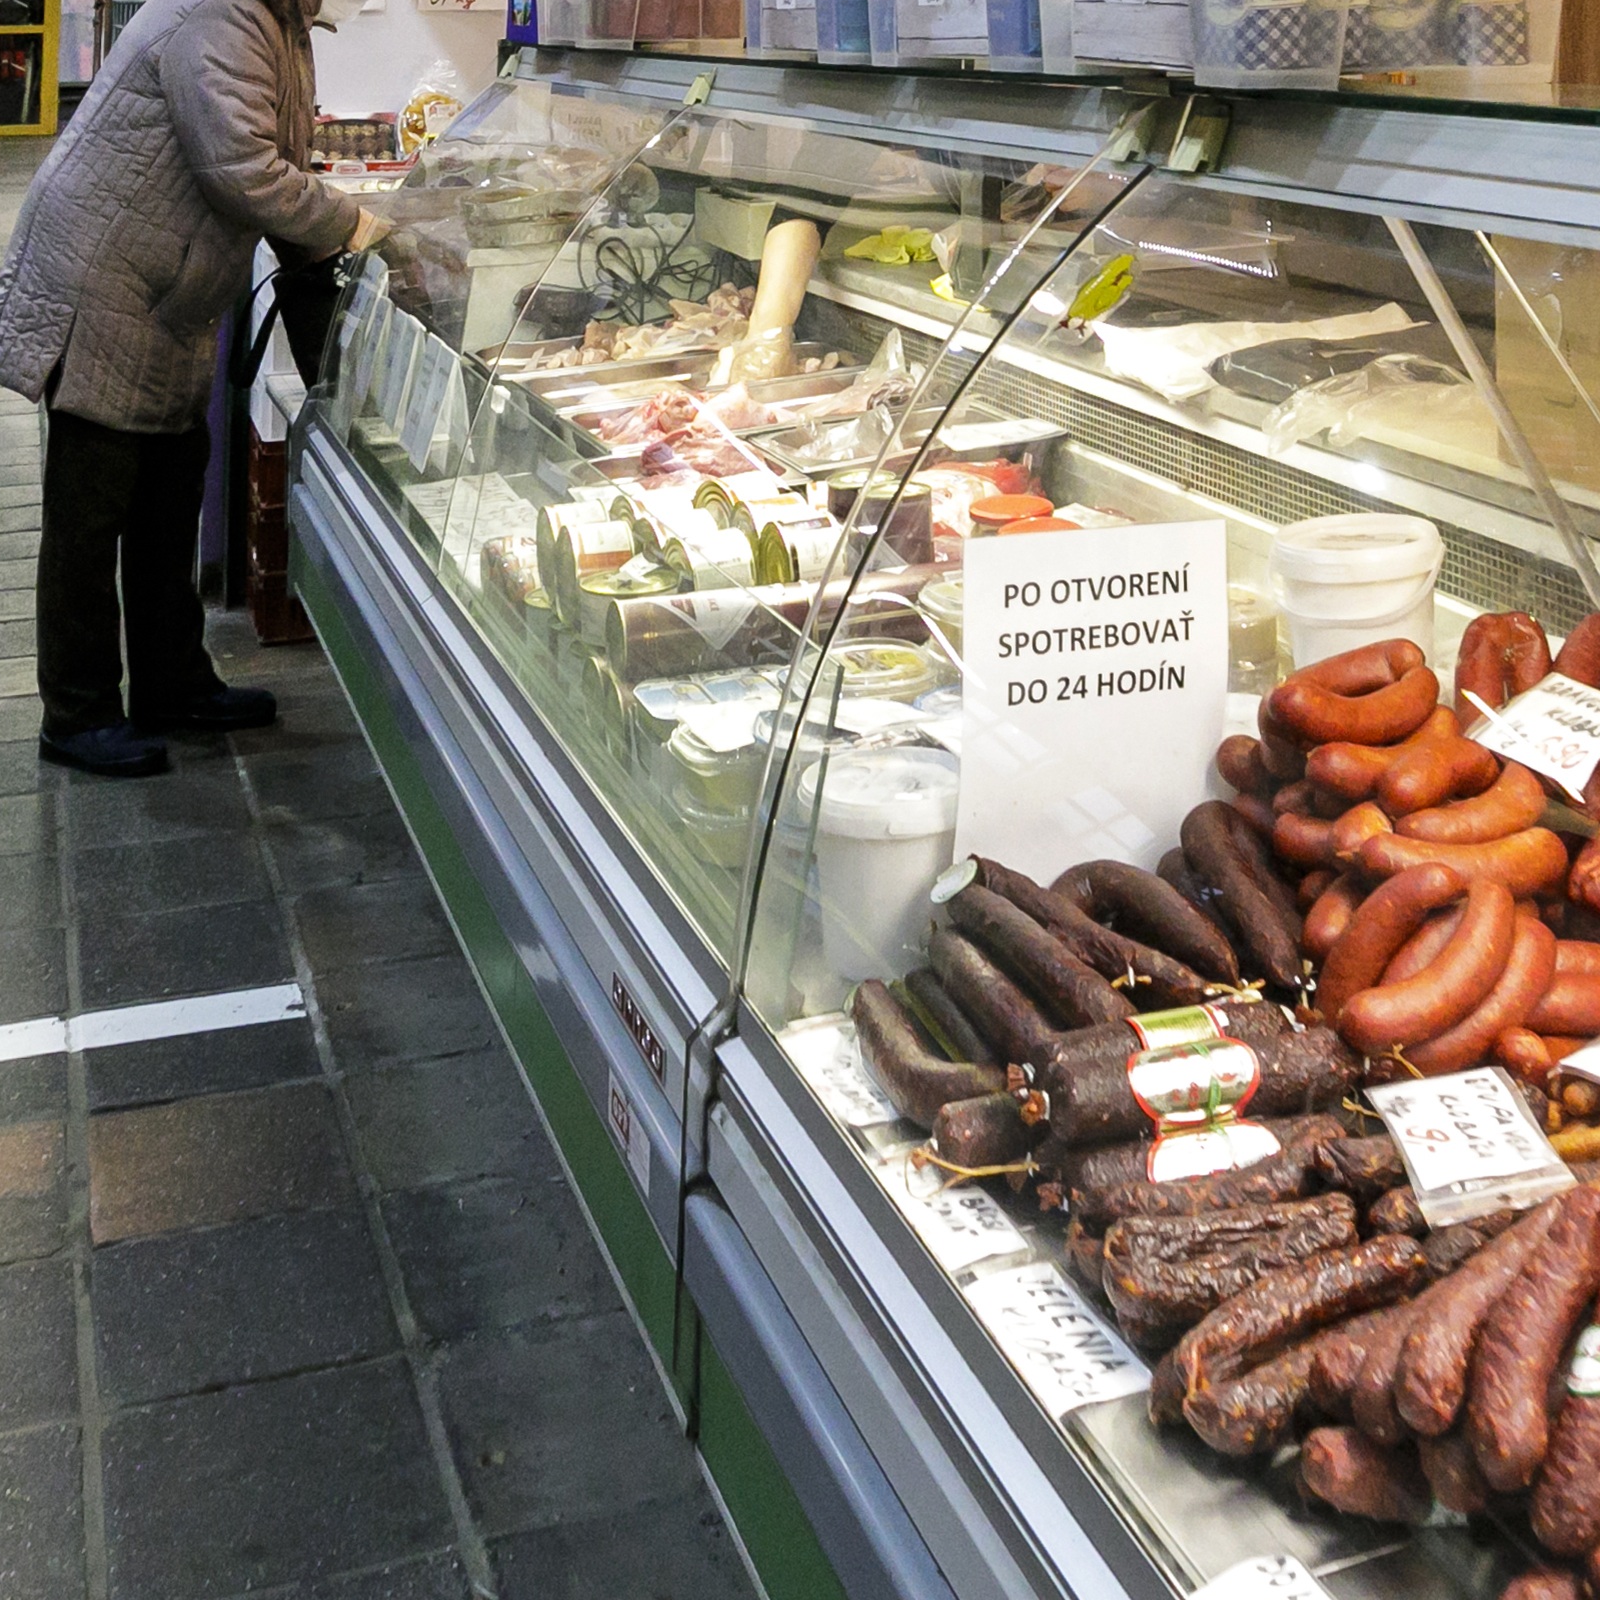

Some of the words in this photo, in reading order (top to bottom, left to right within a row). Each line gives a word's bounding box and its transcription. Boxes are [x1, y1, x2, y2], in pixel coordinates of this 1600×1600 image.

[1002, 581, 1043, 610] PO
[1050, 562, 1191, 606] OTVORENÍ
[997, 614, 1196, 660] SPOTREBOVAŤ
[1006, 678, 1048, 708] DO
[1055, 674, 1089, 703] 24
[1097, 662, 1187, 699] HODÍN
[1016, 1272, 1131, 1374] JELENIA
